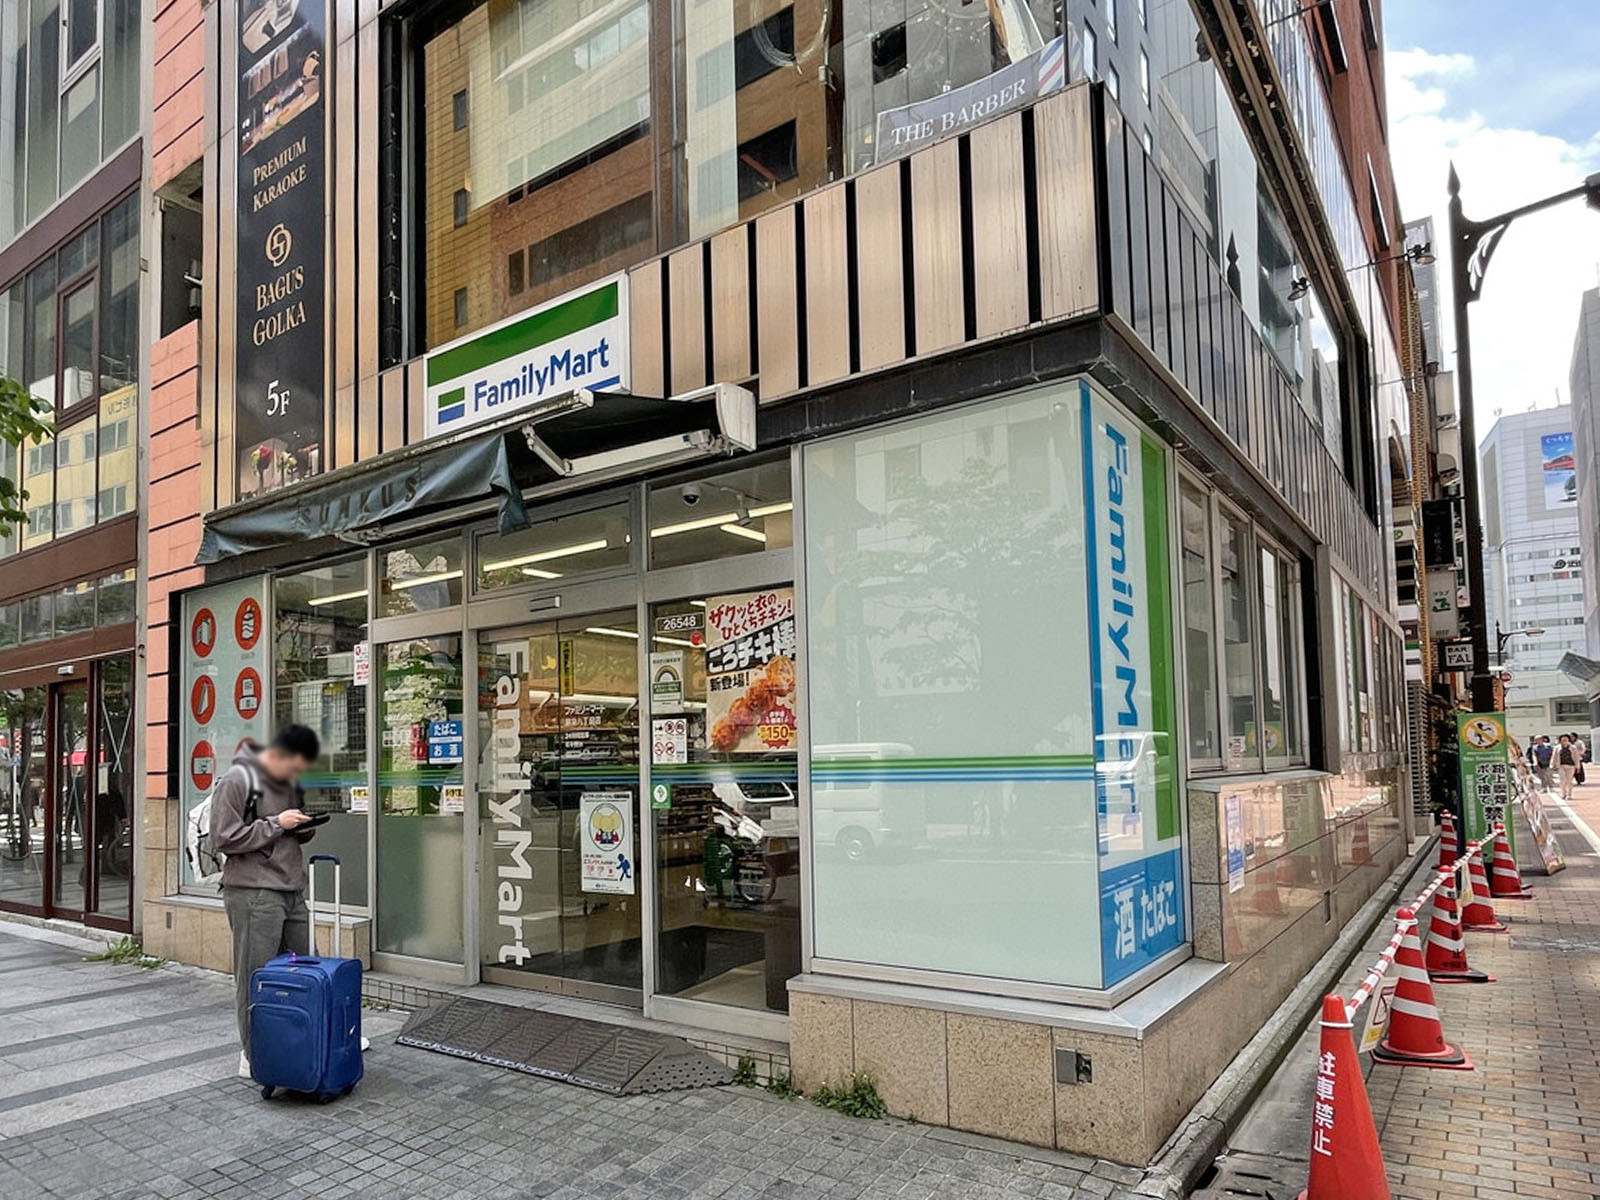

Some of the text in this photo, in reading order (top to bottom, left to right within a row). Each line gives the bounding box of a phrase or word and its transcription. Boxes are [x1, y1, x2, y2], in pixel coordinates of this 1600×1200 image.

[891, 78, 1026, 147] THE BARBER
[252, 134, 308, 187] PREMIUM
[252, 163, 308, 214] KARAOKE
[255, 265, 305, 312] BAGUS
[252, 300, 307, 347] GOLKA
[266, 379, 291, 417] 5F
[473, 337, 610, 412] FamilyMart
[663, 615, 697, 631] 26548
[708, 592, 777, 628] ザクッと衣の
[1104, 421, 1142, 837] FamilyMart
[433, 723, 458, 737] たばこ
[488, 640, 534, 967] FamilyMart
[1113, 880, 1177, 961] 酒 たばこ
